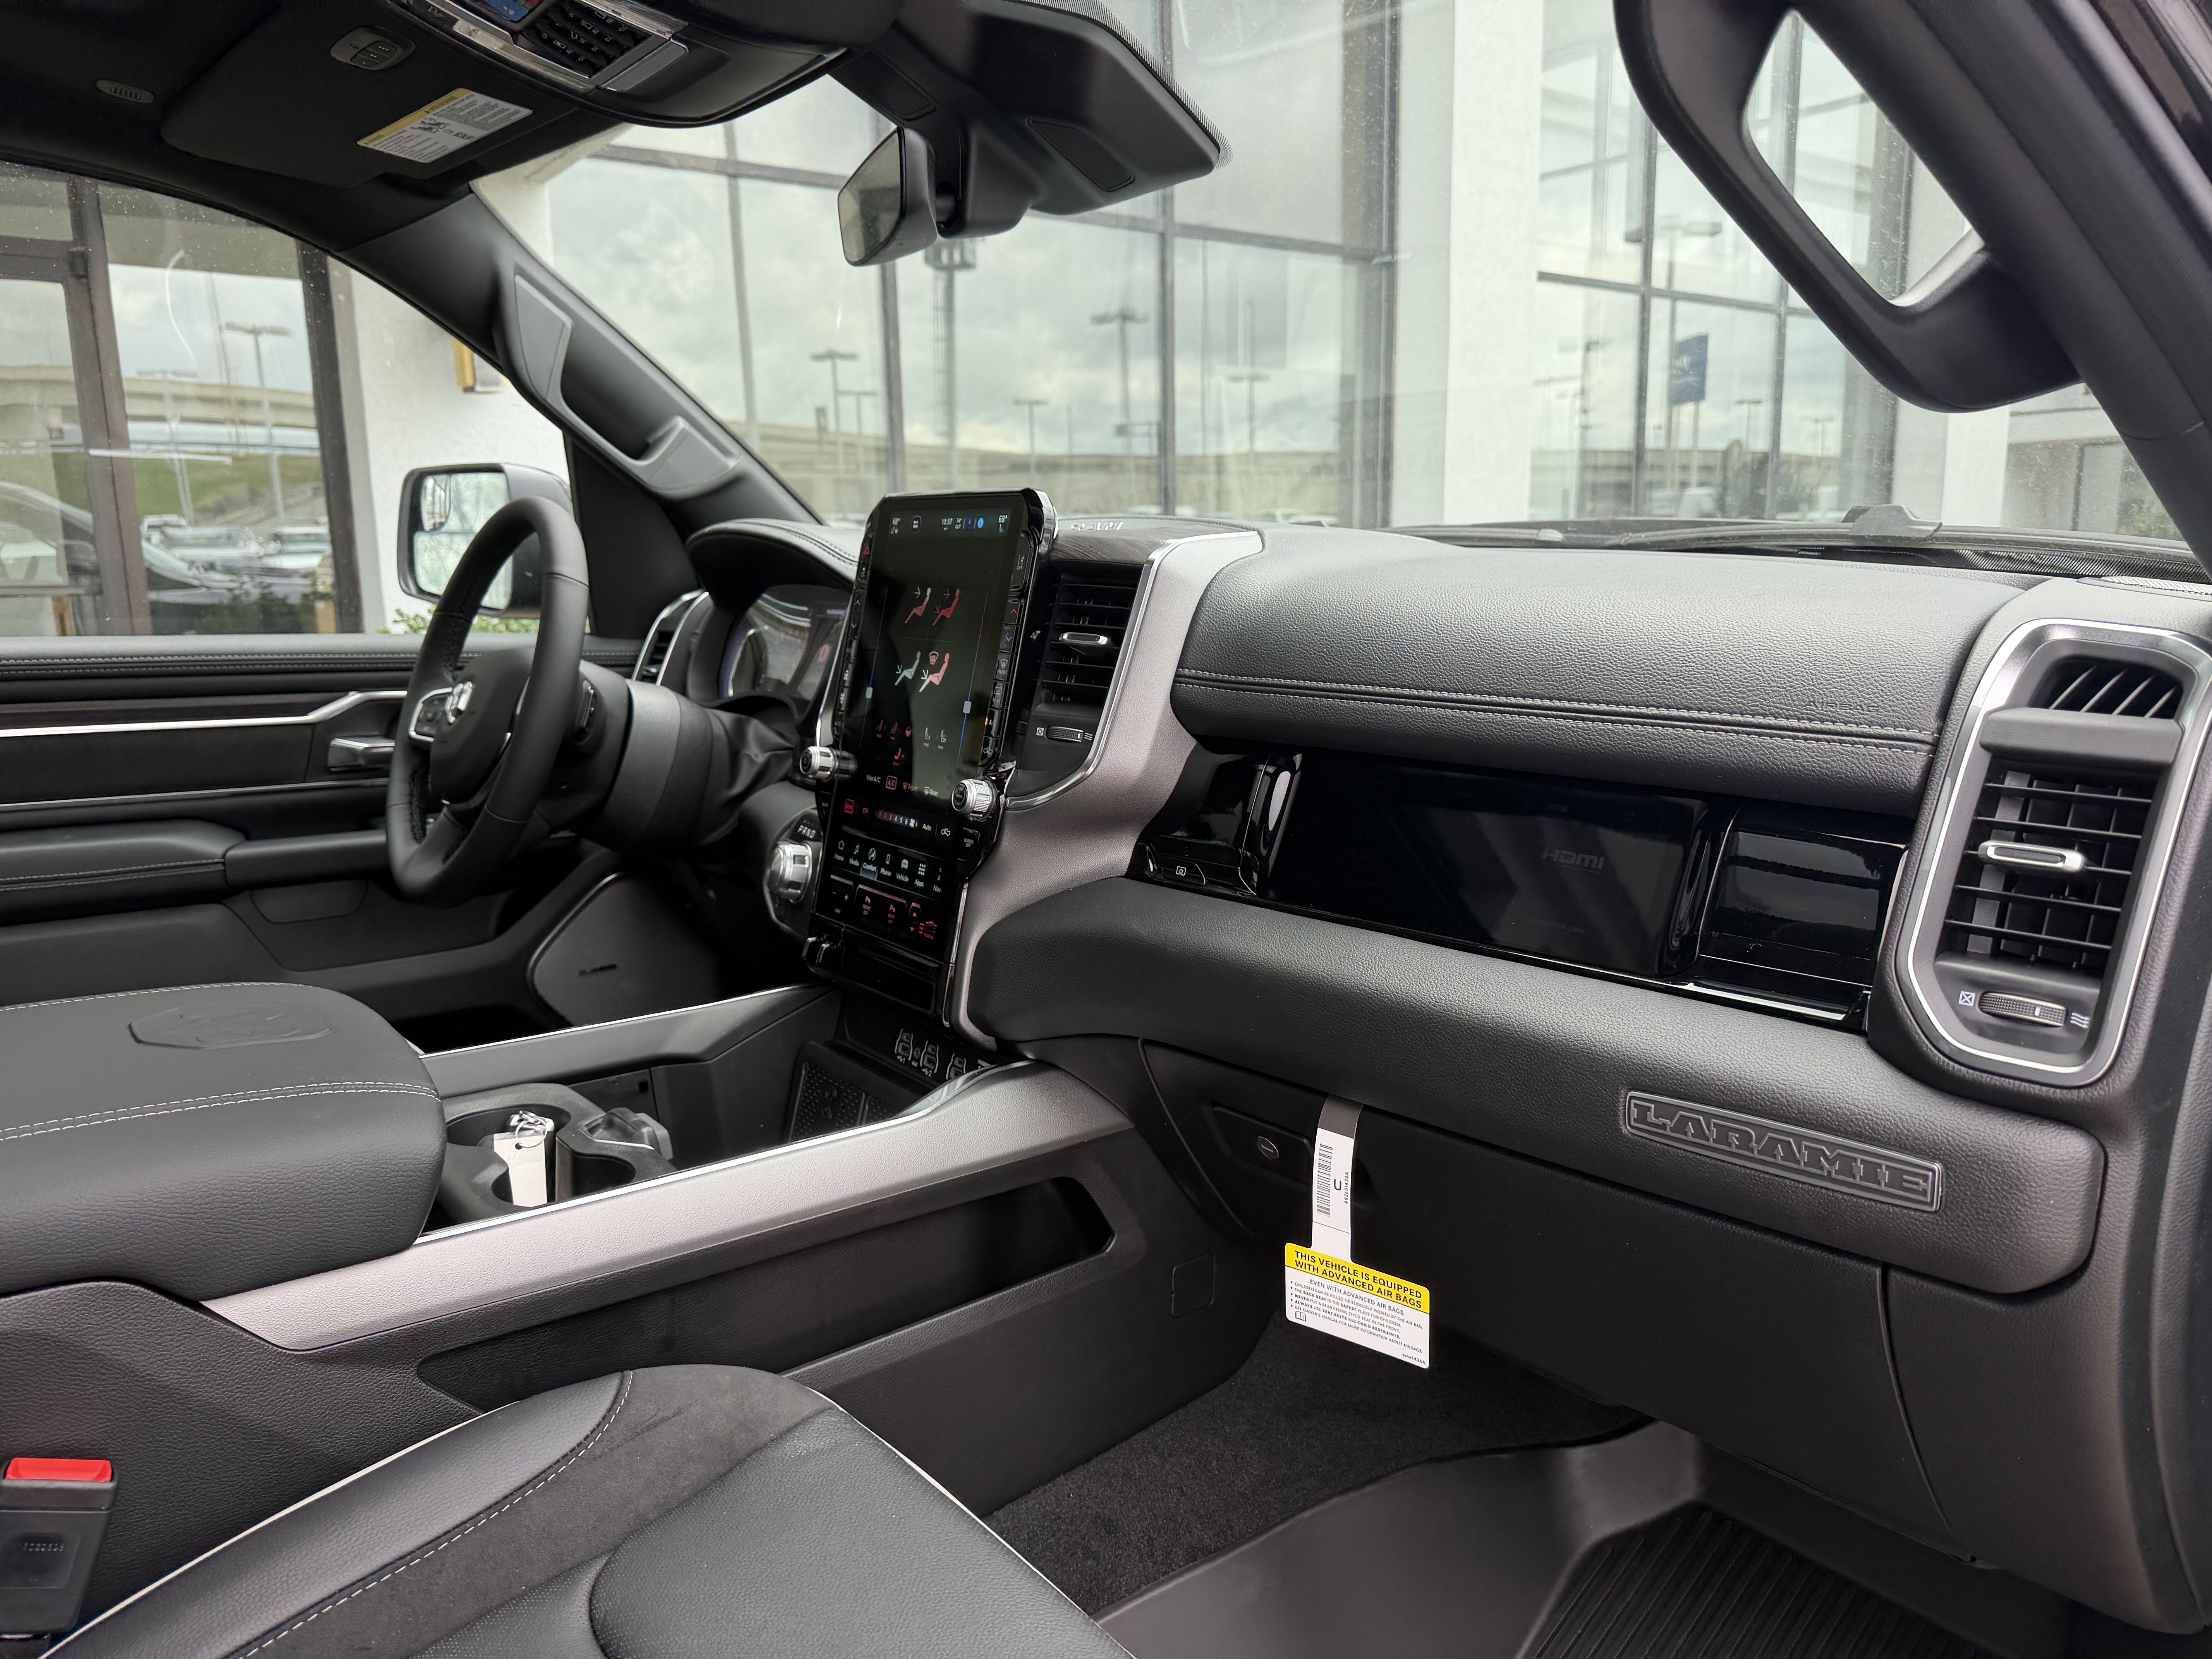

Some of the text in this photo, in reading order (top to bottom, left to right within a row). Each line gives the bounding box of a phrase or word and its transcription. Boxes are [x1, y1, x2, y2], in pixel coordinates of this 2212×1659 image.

[1805, 700, 1879, 713] AIRBAG
[1630, 1099, 1932, 1203] LARAMIE
[1295, 1250, 1422, 1298] THIS VEHICLE IS EQUIPPED
[1295, 1260, 1422, 1309] WITH ADVANCED AIR BAGS
[1295, 1282, 1314, 1291] CHILDREN
[1295, 1294, 1309, 1302] NEVER
[1310, 1279, 1404, 1316] EVEN WITH ADVANCED AIR BAGS
[1340, 1302, 1357, 1312] SAFEST
[1295, 1300, 1313, 1309] ALWAYS
[1357, 1321, 1371, 1329] CHILD
[1389, 1338, 1402, 1346] ABOUT
